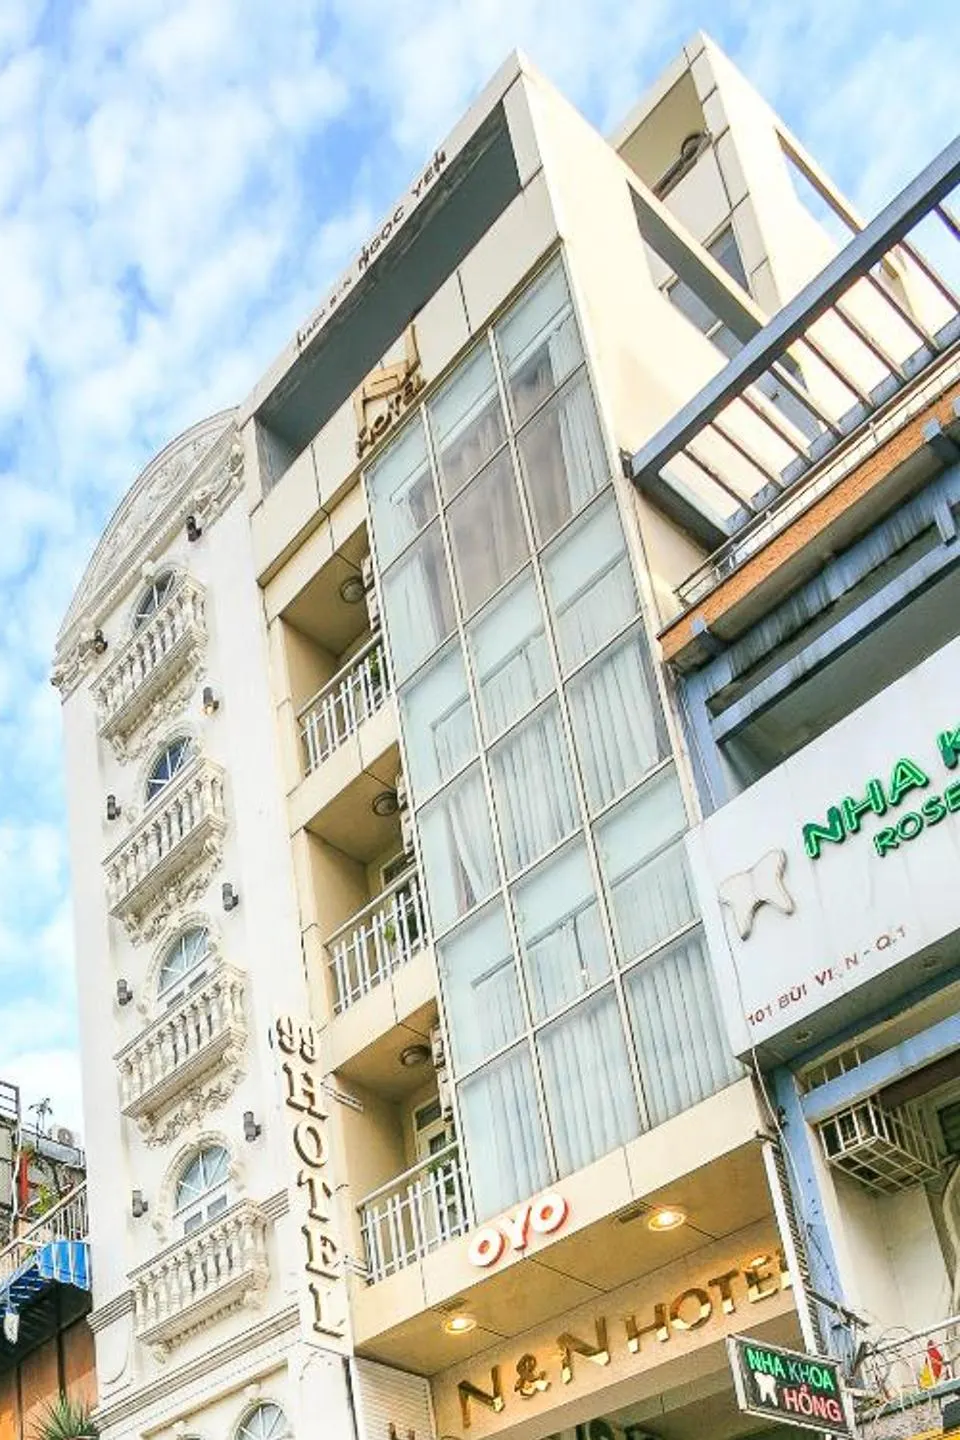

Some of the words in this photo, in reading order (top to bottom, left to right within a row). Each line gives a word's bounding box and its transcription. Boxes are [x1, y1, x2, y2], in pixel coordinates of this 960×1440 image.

[802, 758, 929, 859] NHA
[276, 1014, 318, 1064] 99
[747, 1004, 774, 1026] 101
[282, 1061, 344, 1338] HOTEL
[467, 1191, 570, 1269] OYO
[745, 1347, 787, 1379] NHA
[786, 1360, 836, 1392] KHOA
